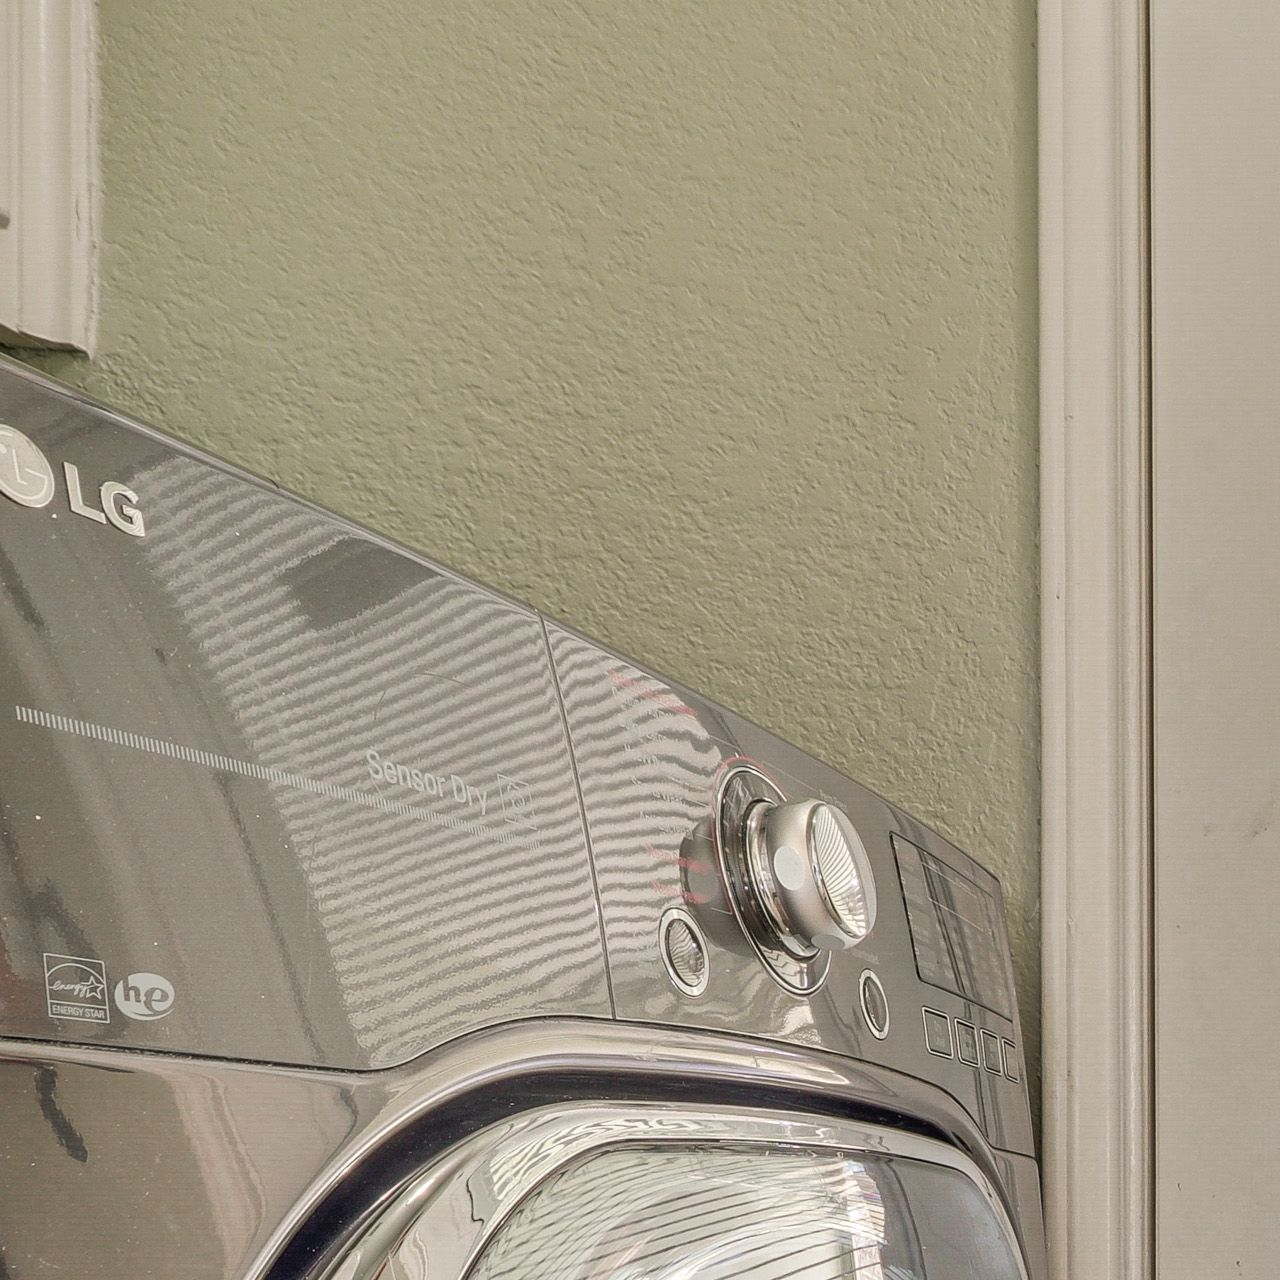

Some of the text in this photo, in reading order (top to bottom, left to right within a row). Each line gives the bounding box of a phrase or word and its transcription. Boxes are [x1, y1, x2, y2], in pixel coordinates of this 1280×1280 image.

[63, 461, 146, 537] LG
[366, 750, 488, 815] Sensor Dry
[52, 1004, 105, 1018] ENERGY STAR
